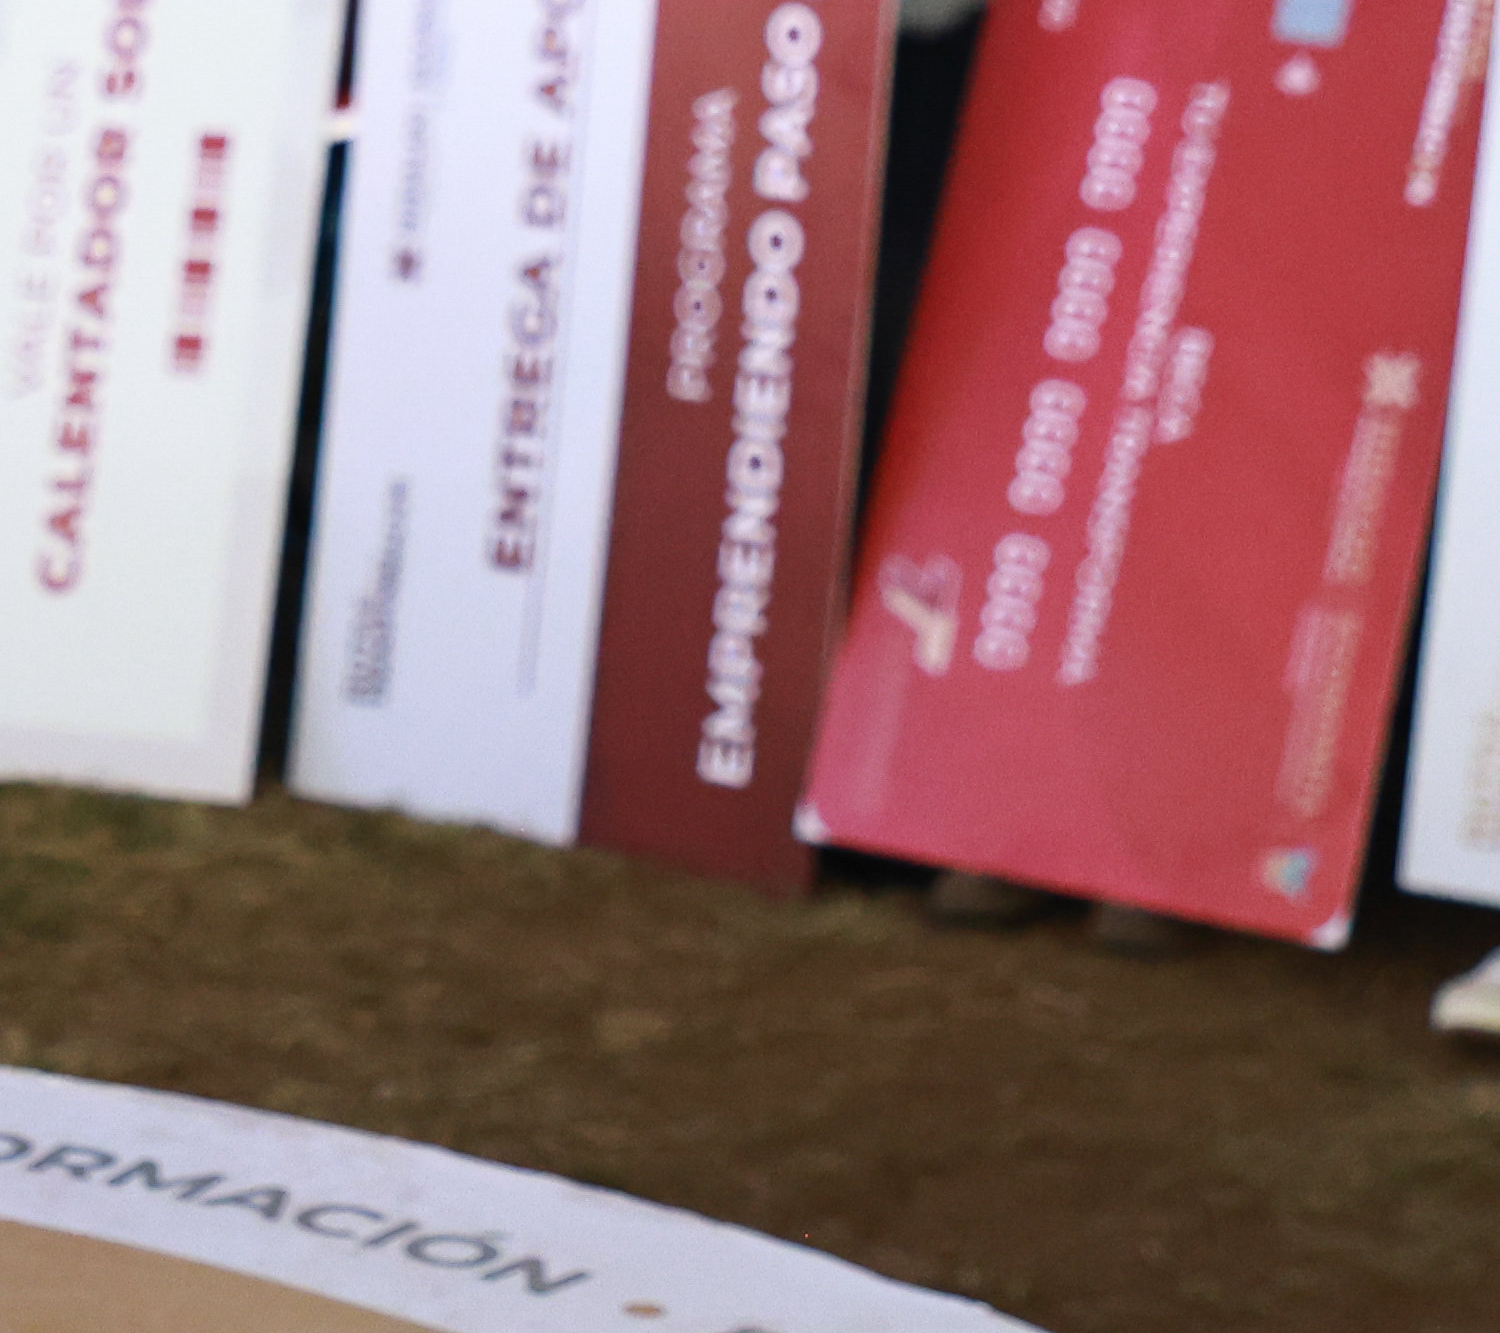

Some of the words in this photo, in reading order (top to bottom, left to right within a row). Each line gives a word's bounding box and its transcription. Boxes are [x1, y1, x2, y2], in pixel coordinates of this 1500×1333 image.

[521, 139, 571, 229] DE
[667, 86, 741, 402] PROGRAMA
[36, 130, 130, 593] CALENTADOR
[488, 255, 560, 575] ENTREGA
[696, 209, 805, 789] EMPRENDIENDO
[752, 1, 825, 203] PASO
